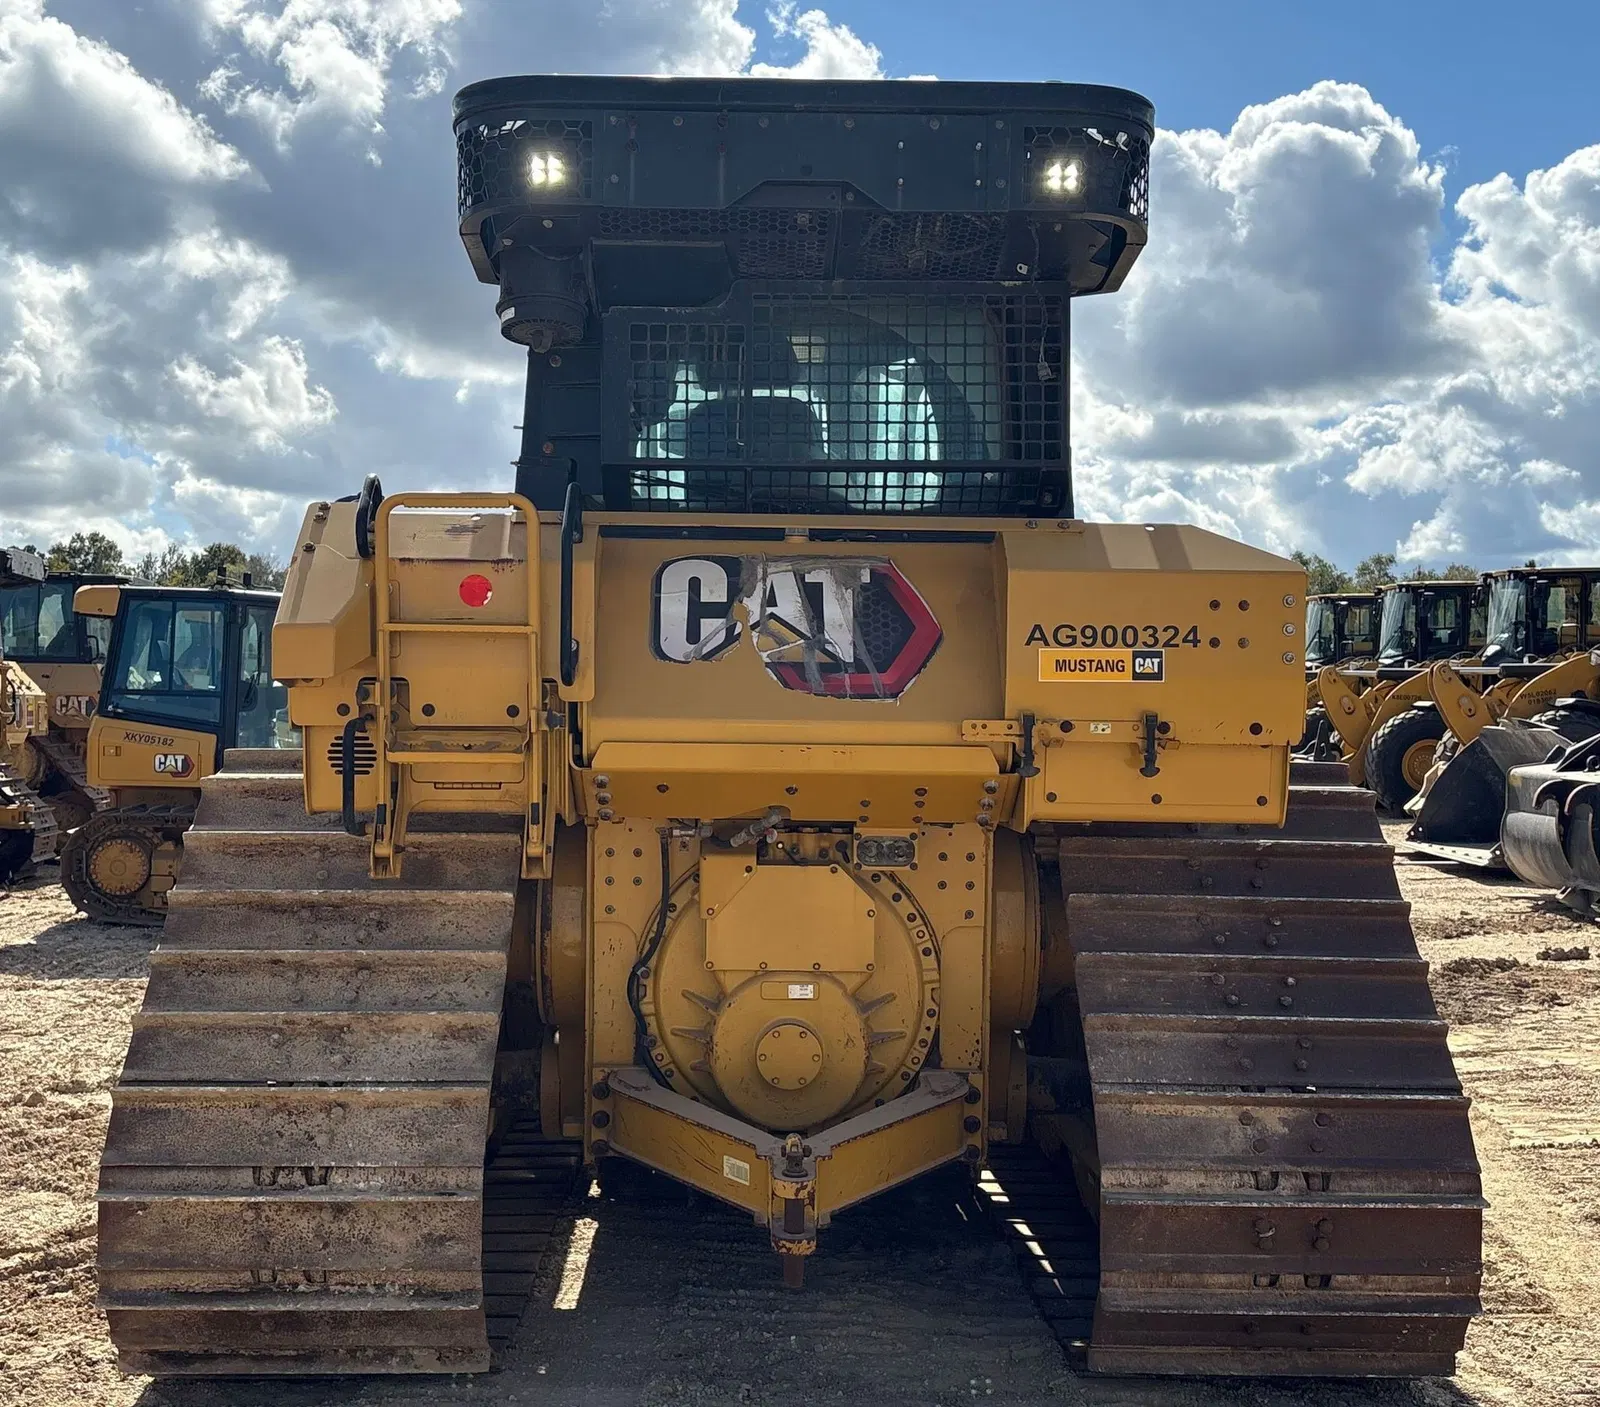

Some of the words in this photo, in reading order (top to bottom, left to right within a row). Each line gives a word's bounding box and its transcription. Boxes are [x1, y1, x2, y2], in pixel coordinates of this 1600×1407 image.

[660, 560, 870, 662] CAT
[1024, 623, 1201, 648] AG900324
[1055, 659, 1126, 673] MUSTANG
[1135, 657, 1161, 674] CAT
[55, 695, 90, 716] CAT
[123, 731, 175, 747] XKY05182
[155, 754, 185, 773] CAT
